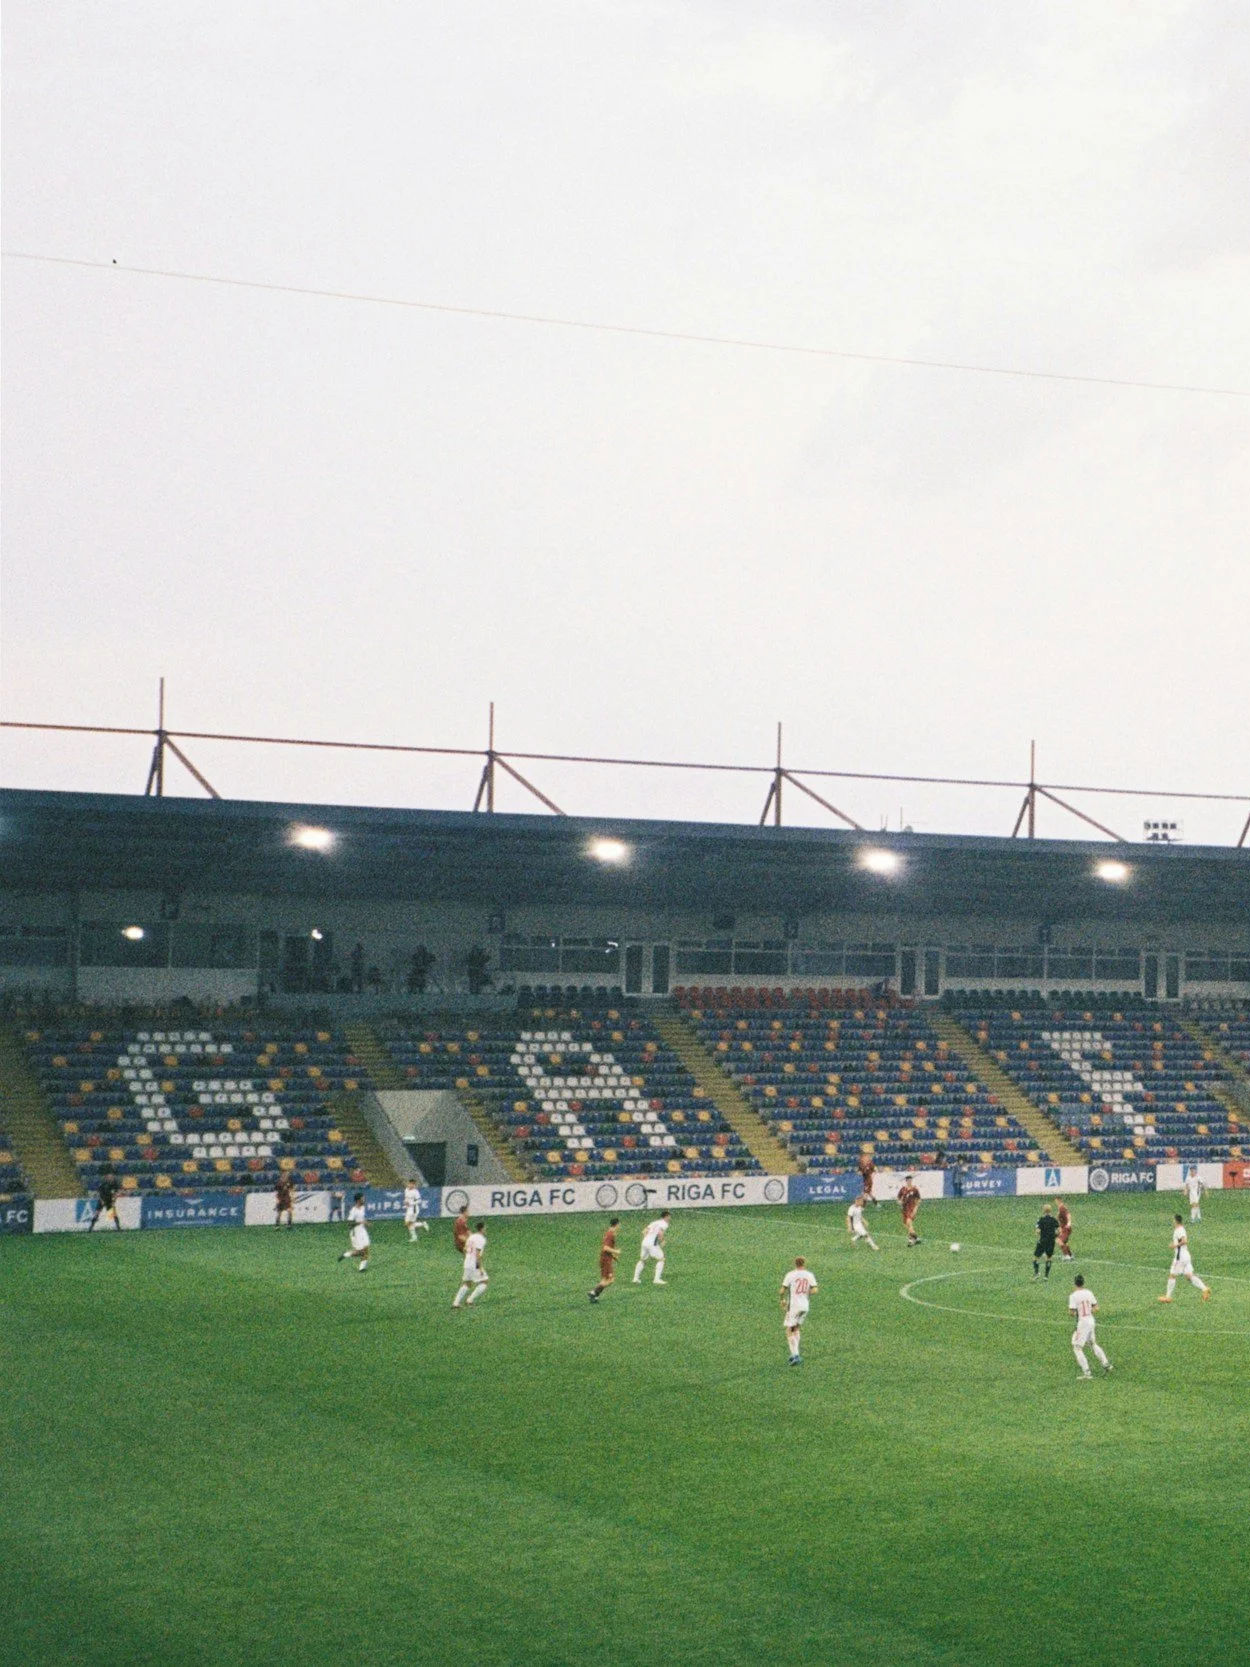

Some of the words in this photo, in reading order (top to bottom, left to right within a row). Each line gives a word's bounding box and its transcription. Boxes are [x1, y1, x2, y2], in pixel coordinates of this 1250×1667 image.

[1111, 1172, 1137, 1184] RIGA
[1139, 1171, 1155, 1183] FC
[667, 1182, 715, 1201] RIGA
[721, 1182, 746, 1199] FC
[808, 1185, 847, 1195] LEGAL
[490, 1190, 543, 1209] RIGA
[550, 1188, 576, 1205] FC
[6, 1209, 29, 1223] FC
[147, 1207, 238, 1220] INSURANCE
[795, 1277, 809, 1295] 20
